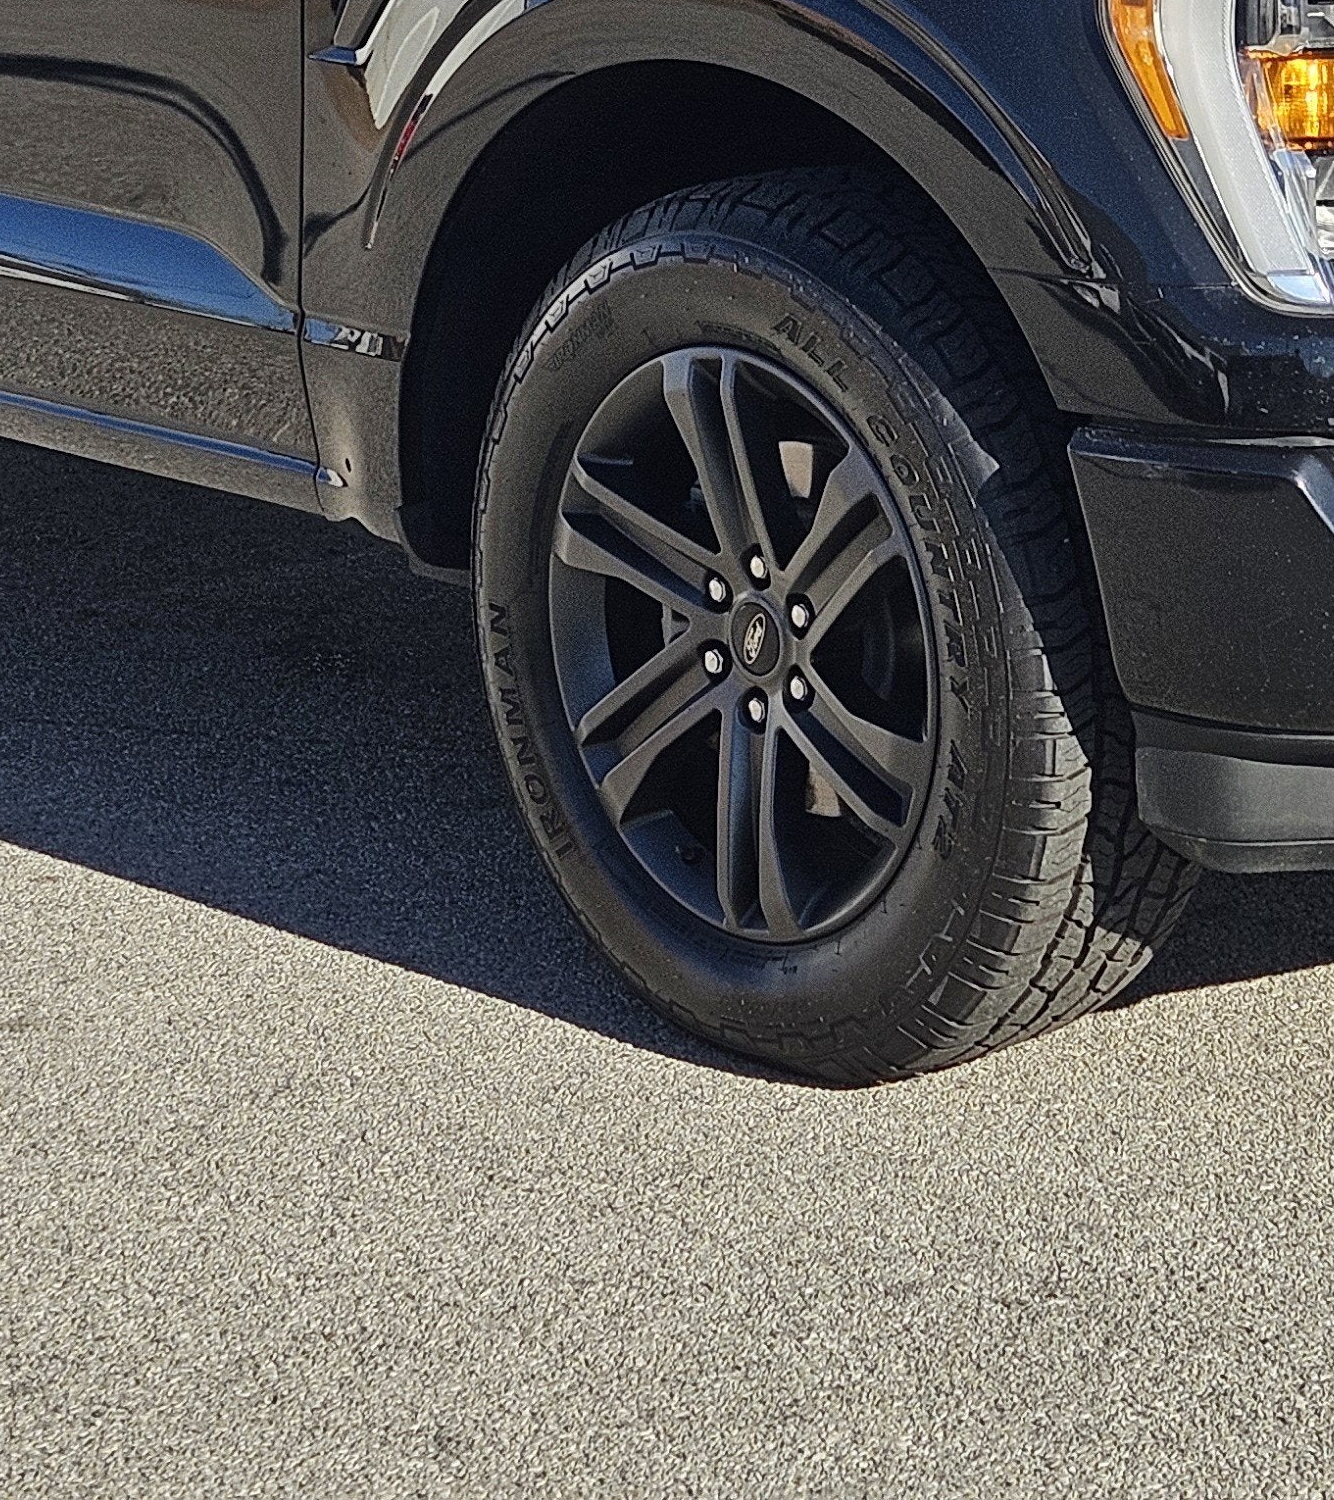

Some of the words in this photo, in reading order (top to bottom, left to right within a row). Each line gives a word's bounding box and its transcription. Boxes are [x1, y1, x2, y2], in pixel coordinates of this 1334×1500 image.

[772, 312, 849, 393] ALL
[866, 413, 971, 721] COUNTRY
[488, 601, 578, 859] IRONMAN
